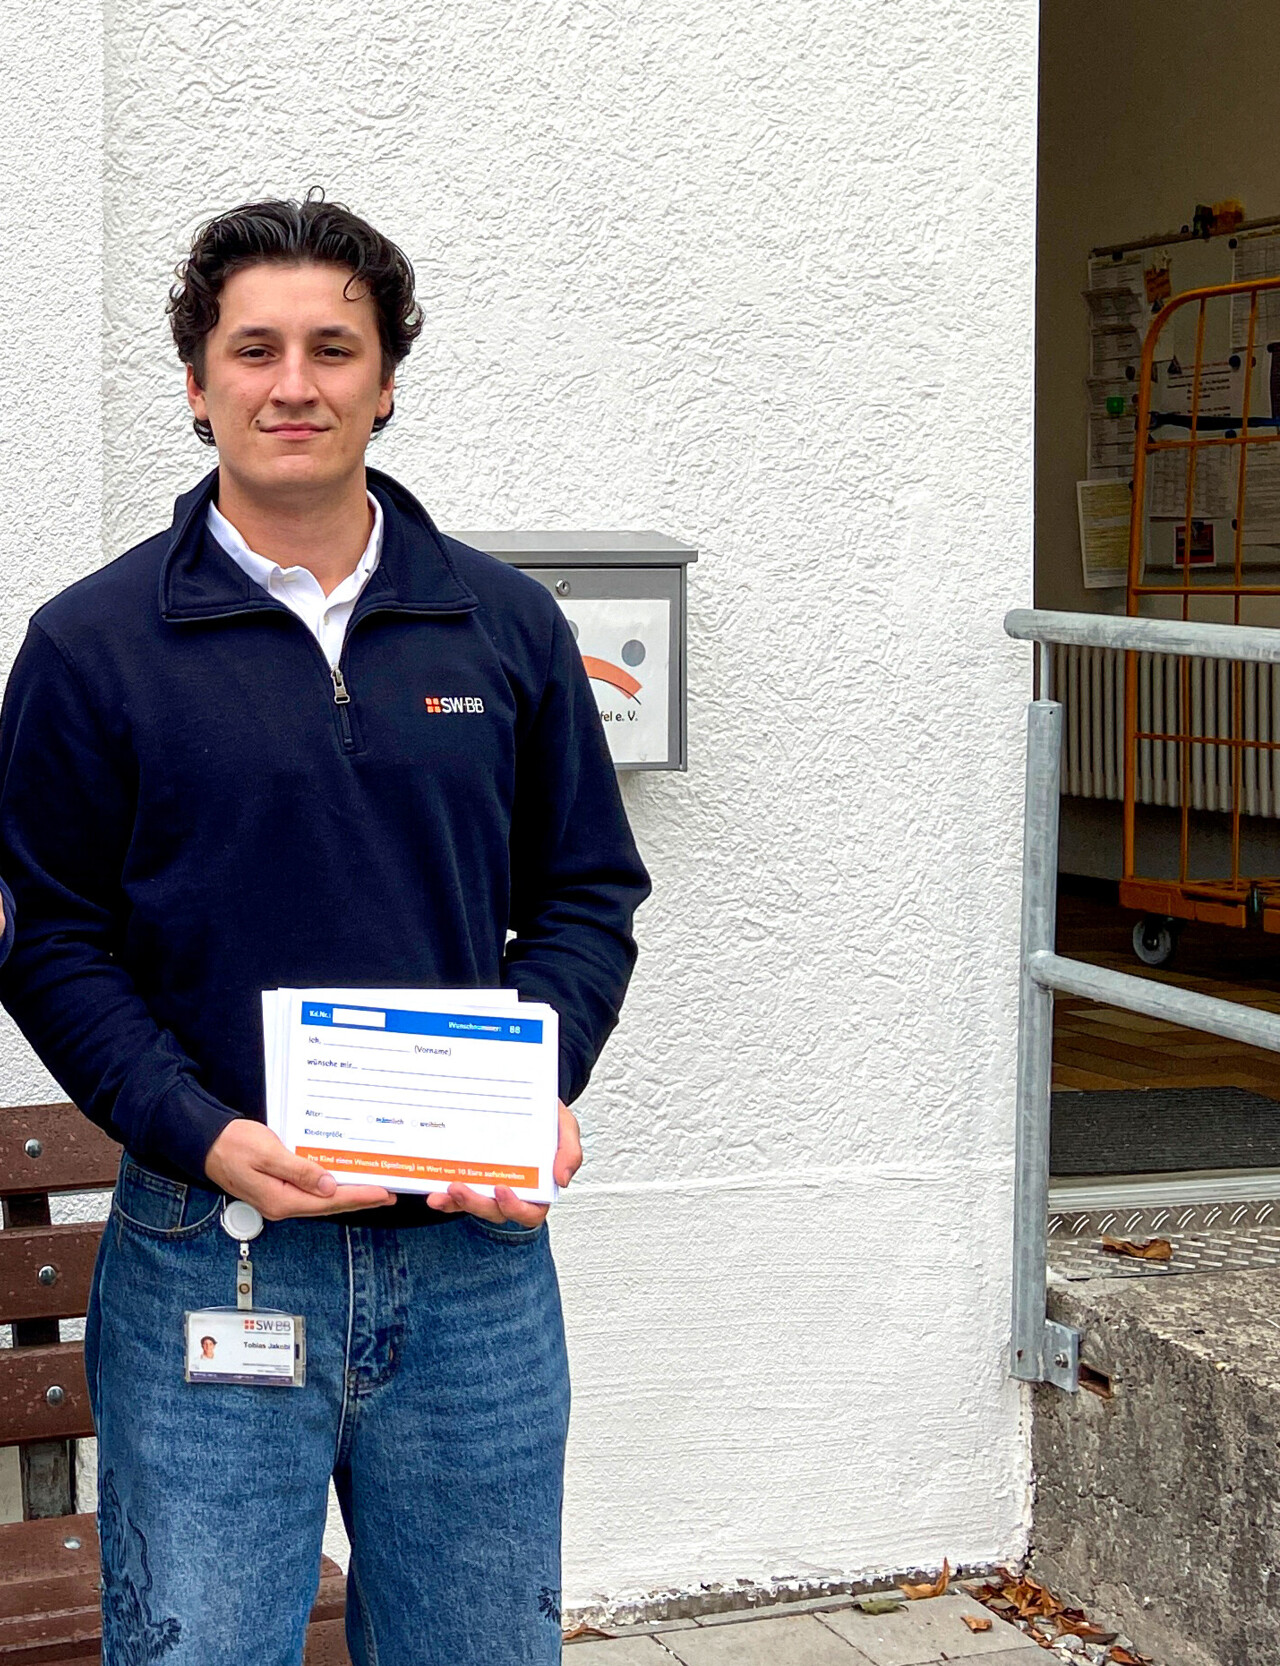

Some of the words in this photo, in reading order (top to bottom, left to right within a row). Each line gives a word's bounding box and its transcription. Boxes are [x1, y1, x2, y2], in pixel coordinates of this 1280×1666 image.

[616, 713, 625, 721] e.
[628, 711, 638, 721] V.
[415, 1045, 452, 1056] (Vorname)
[244, 1341, 266, 1349] Tobias
